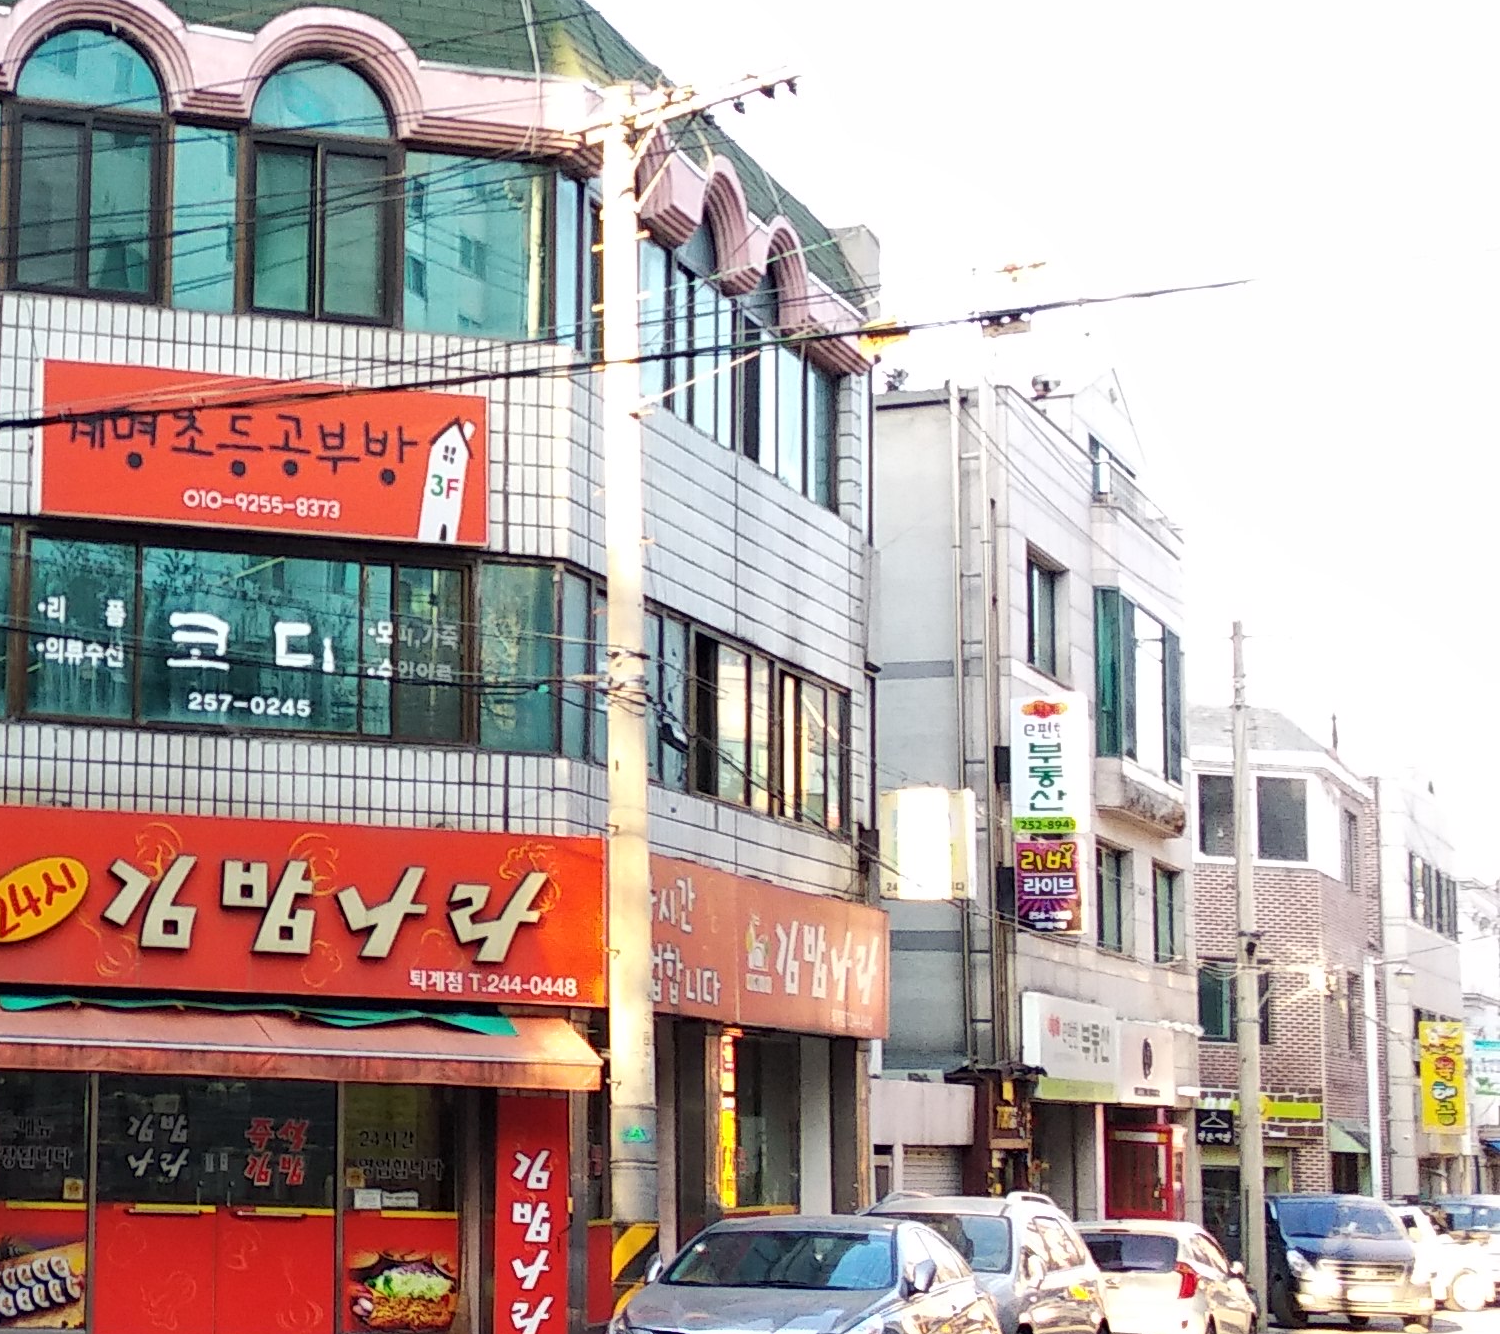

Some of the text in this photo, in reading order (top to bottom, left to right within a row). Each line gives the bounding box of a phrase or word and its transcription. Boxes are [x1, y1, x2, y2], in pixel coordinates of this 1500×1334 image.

[67, 406, 419, 486] 계명초등공부방
[429, 473, 460, 500] 3F
[183, 487, 341, 520] 010-9255-8373
[44, 636, 125, 668] 의류수선
[187, 692, 312, 718] 257-0245
[1028, 742, 1067, 812] 부동산
[1022, 876, 1077, 897] 라이브
[103, 854, 550, 964] 김밥나라
[651, 940, 722, 1006] 업합니다
[774, 919, 880, 1006] 김밥나라
[408, 967, 578, 998] 퇴계점 T.244-0448
